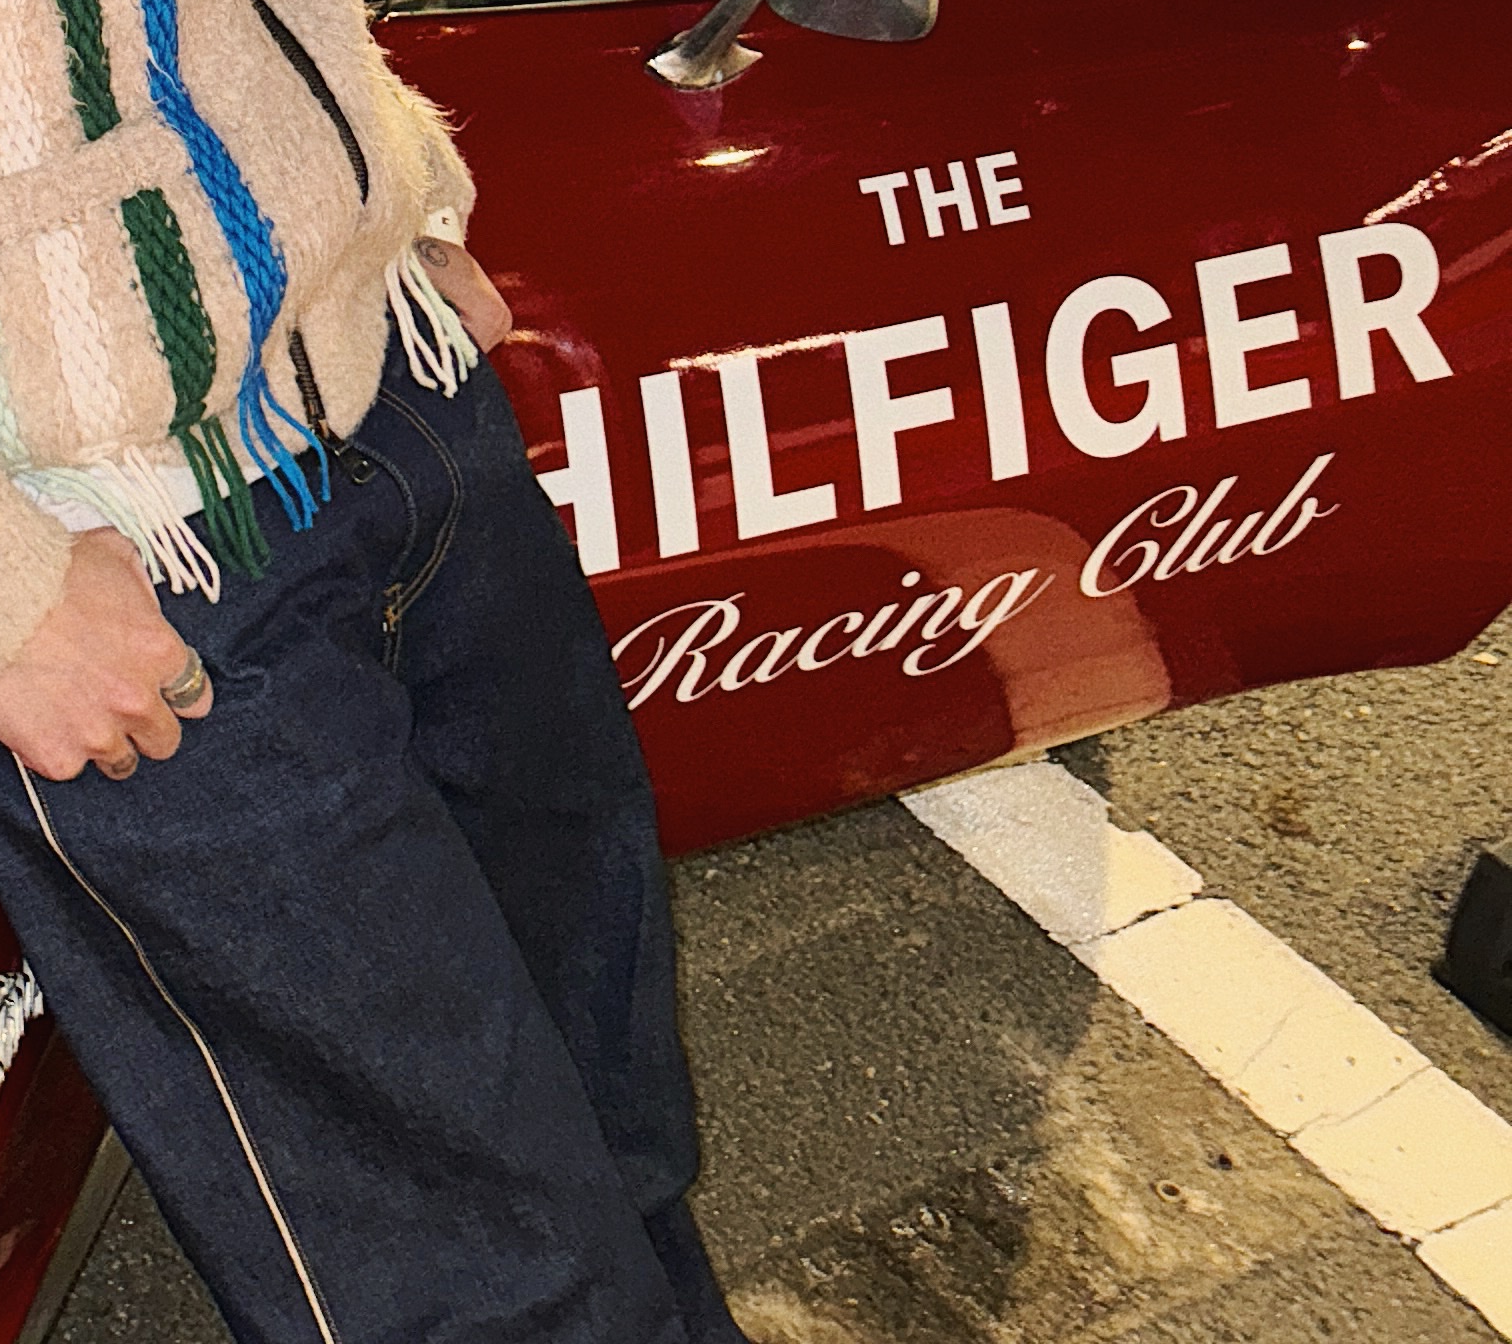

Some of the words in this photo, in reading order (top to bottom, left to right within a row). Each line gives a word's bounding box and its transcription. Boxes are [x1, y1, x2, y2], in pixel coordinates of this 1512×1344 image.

[859, 151, 1031, 246] THE
[612, 567, 1058, 710] Racing
[1079, 451, 1340, 599] Club
